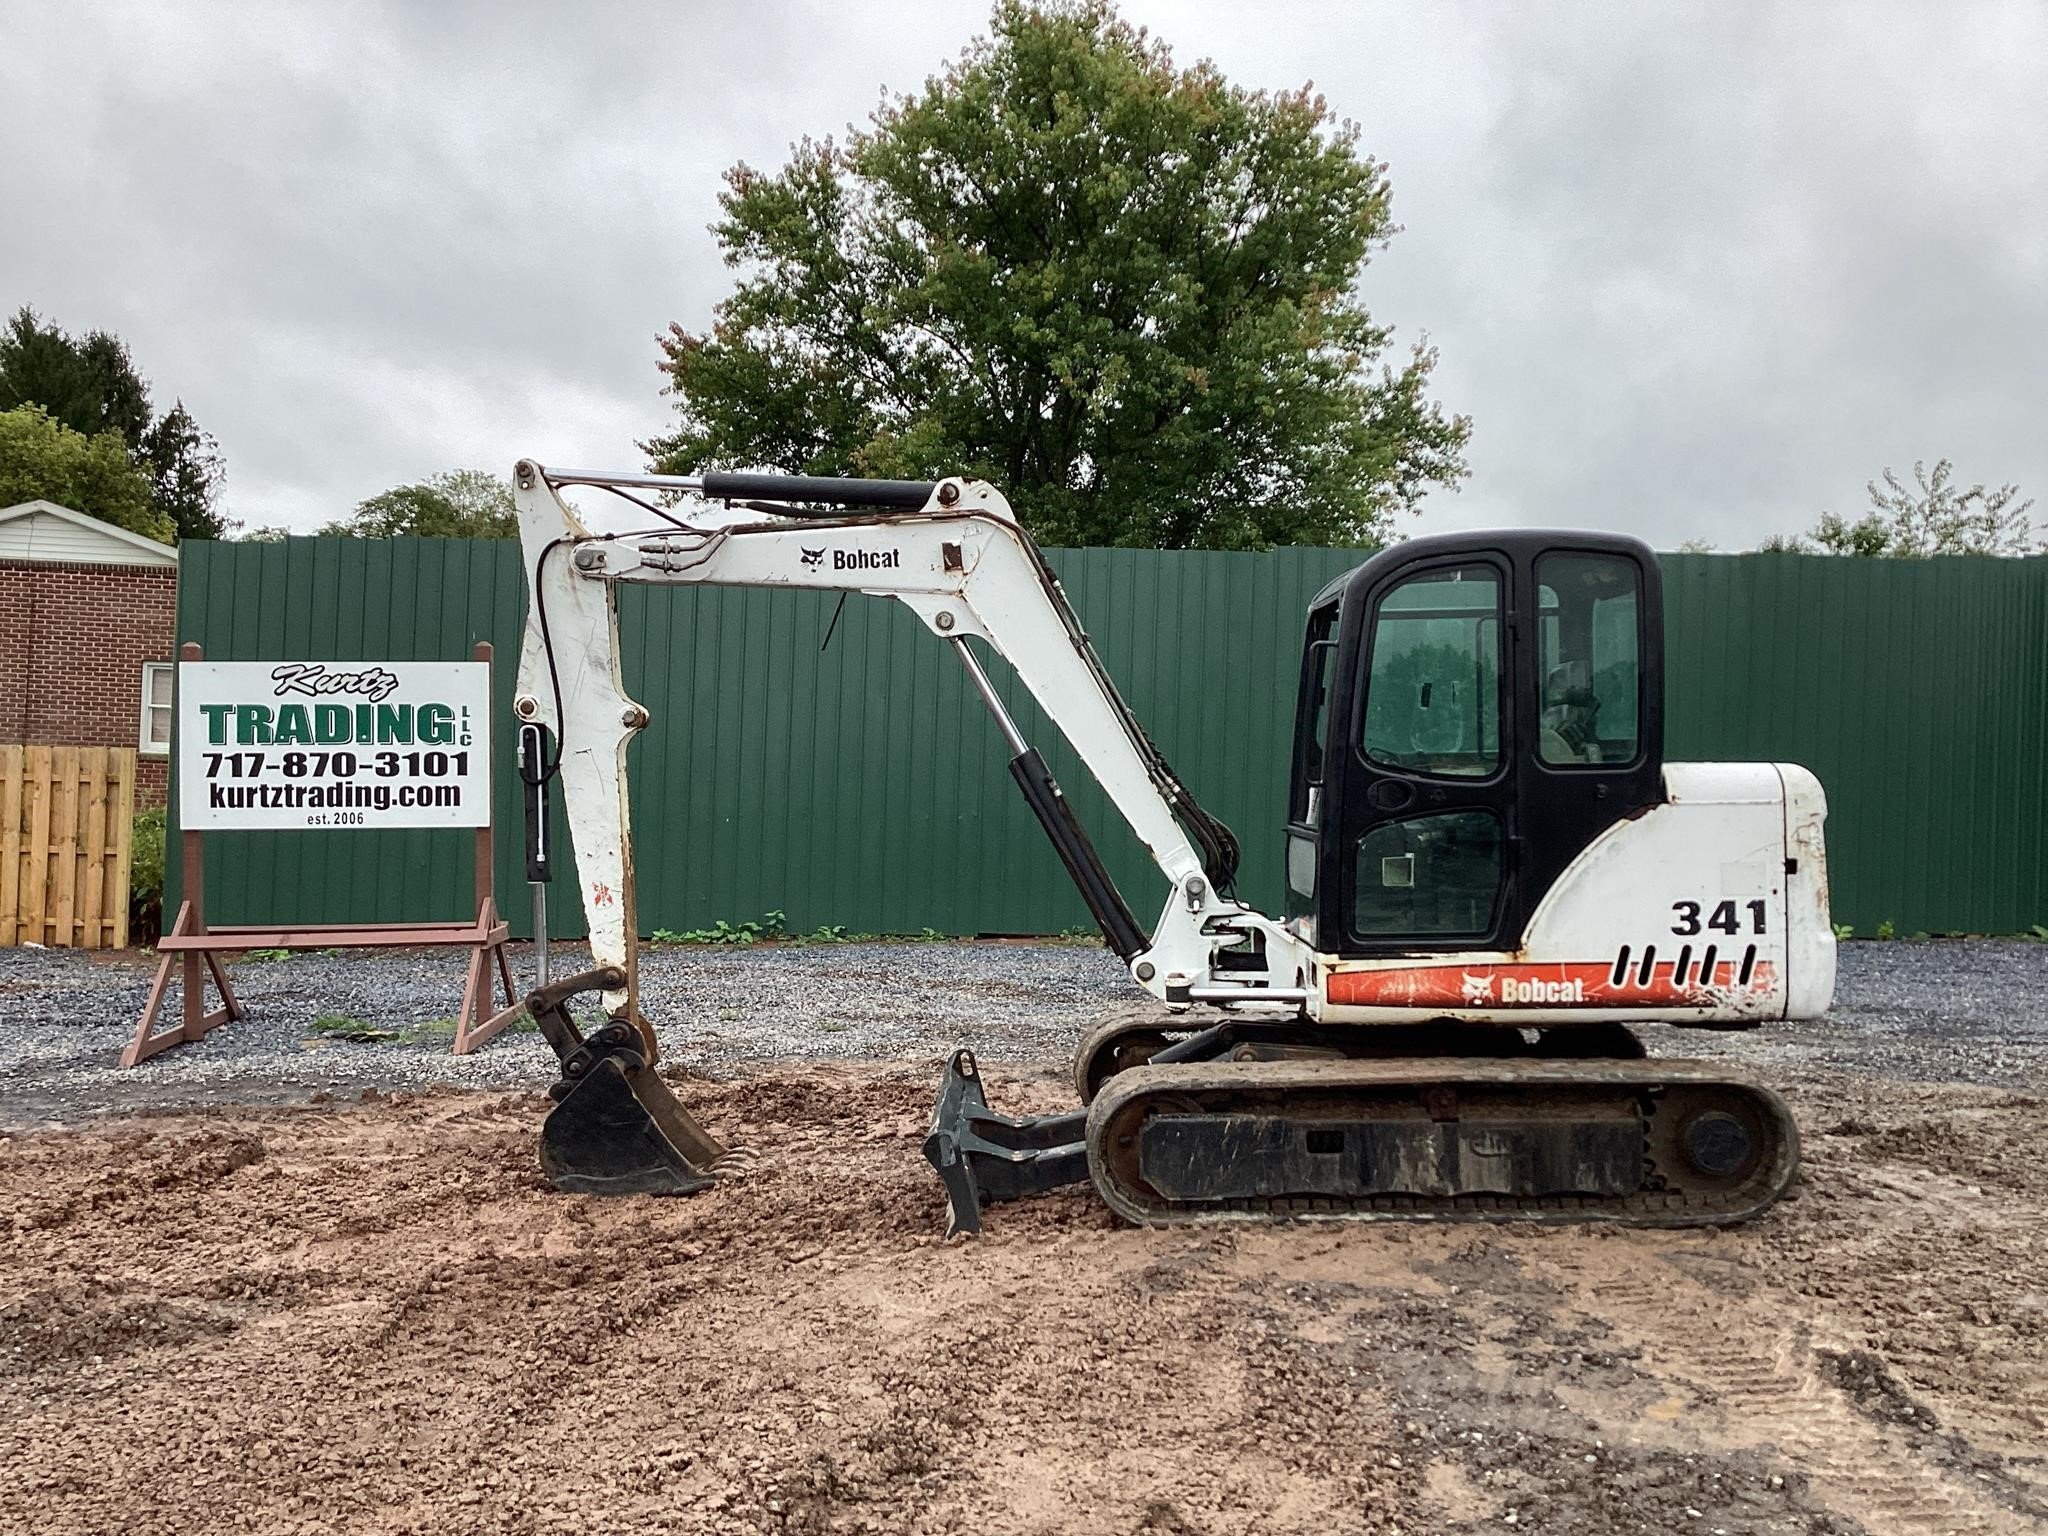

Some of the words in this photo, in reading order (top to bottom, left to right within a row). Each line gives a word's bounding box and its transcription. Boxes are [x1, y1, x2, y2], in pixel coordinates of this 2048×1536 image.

[271, 664, 399, 702] Kurtz
[200, 703, 455, 745] TRADING
[460, 705, 473, 747] LLC
[202, 751, 468, 778] 717-870-3101
[209, 781, 461, 811] kurtztrading.com
[307, 814, 331, 825] est.
[333, 812, 364, 825] 2006
[1670, 900, 1767, 936] 341
[1501, 976, 1584, 1003] Bobcat
